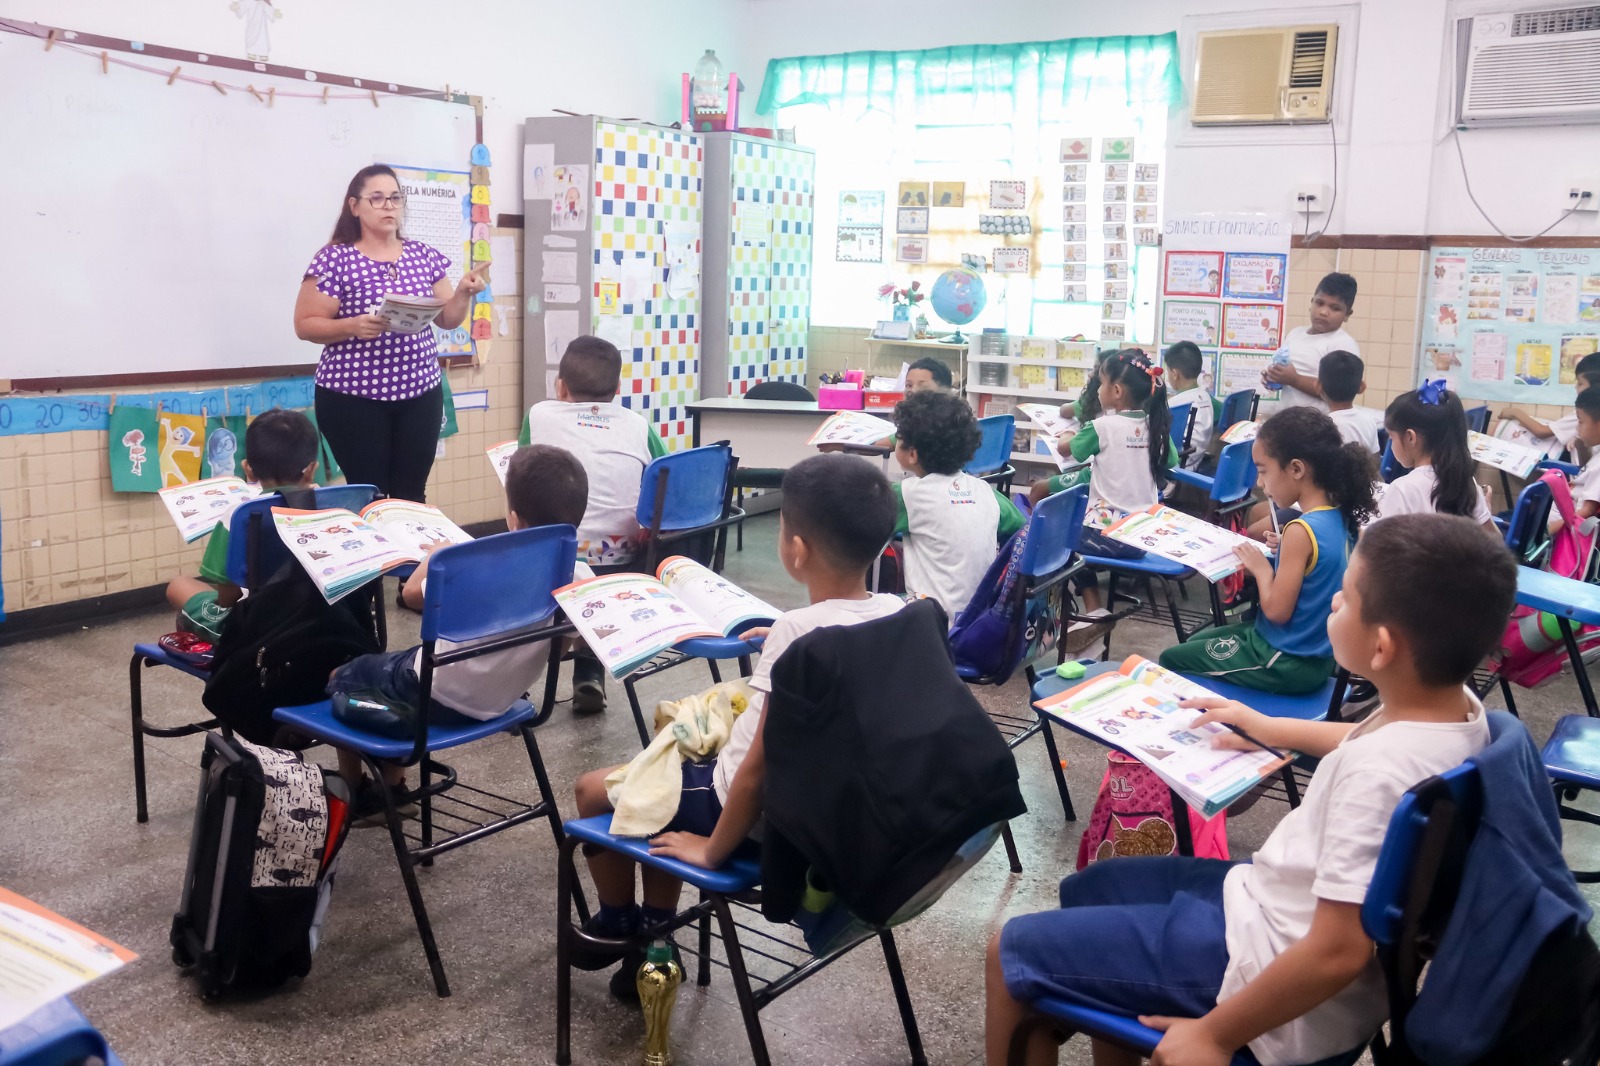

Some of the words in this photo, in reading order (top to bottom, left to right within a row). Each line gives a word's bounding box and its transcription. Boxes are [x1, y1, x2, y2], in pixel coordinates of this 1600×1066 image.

[421, 185, 456, 199] NUMÉRICA
[1165, 220, 1199, 235] SINAIS
[1203, 220, 1216, 235] DE
[1218, 218, 1280, 237] PONTUAÇÃO
[199, 396, 219, 414] 60
[234, 394, 254, 414] 70
[268, 386, 288, 406] 80
[0, 404, 13, 428] 0
[35, 403, 64, 428] 20
[77, 402, 101, 422] 30
[577, 413, 610, 423] Manaus
